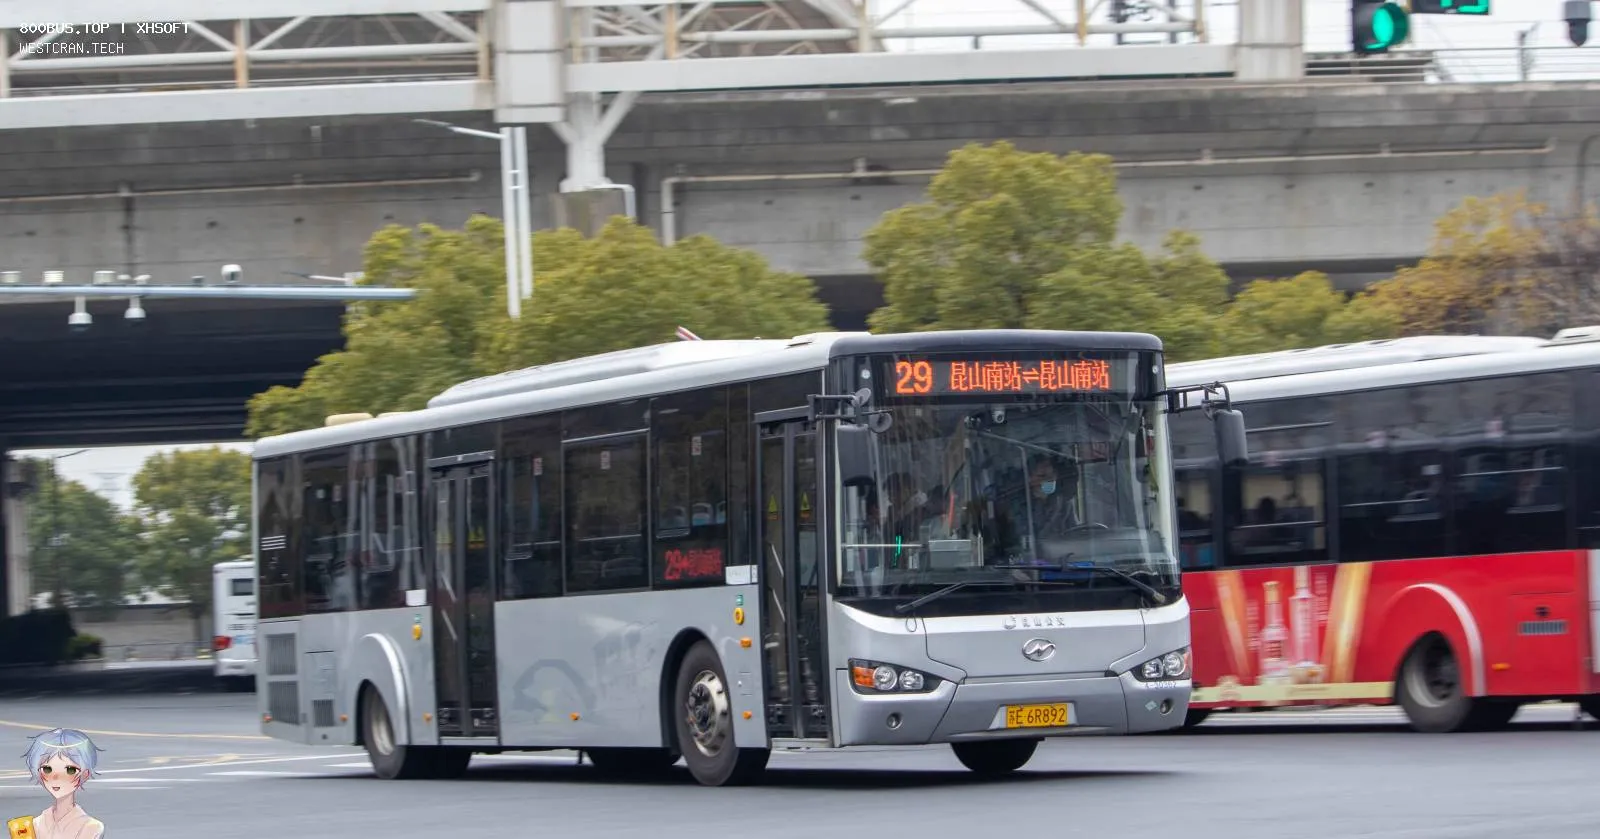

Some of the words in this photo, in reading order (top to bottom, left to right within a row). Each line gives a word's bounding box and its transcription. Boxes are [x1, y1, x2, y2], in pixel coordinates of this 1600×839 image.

[896, 361, 932, 393] 29
[951, 361, 1021, 391] 昆山南站
[1039, 360, 1109, 390] 昆山南站
